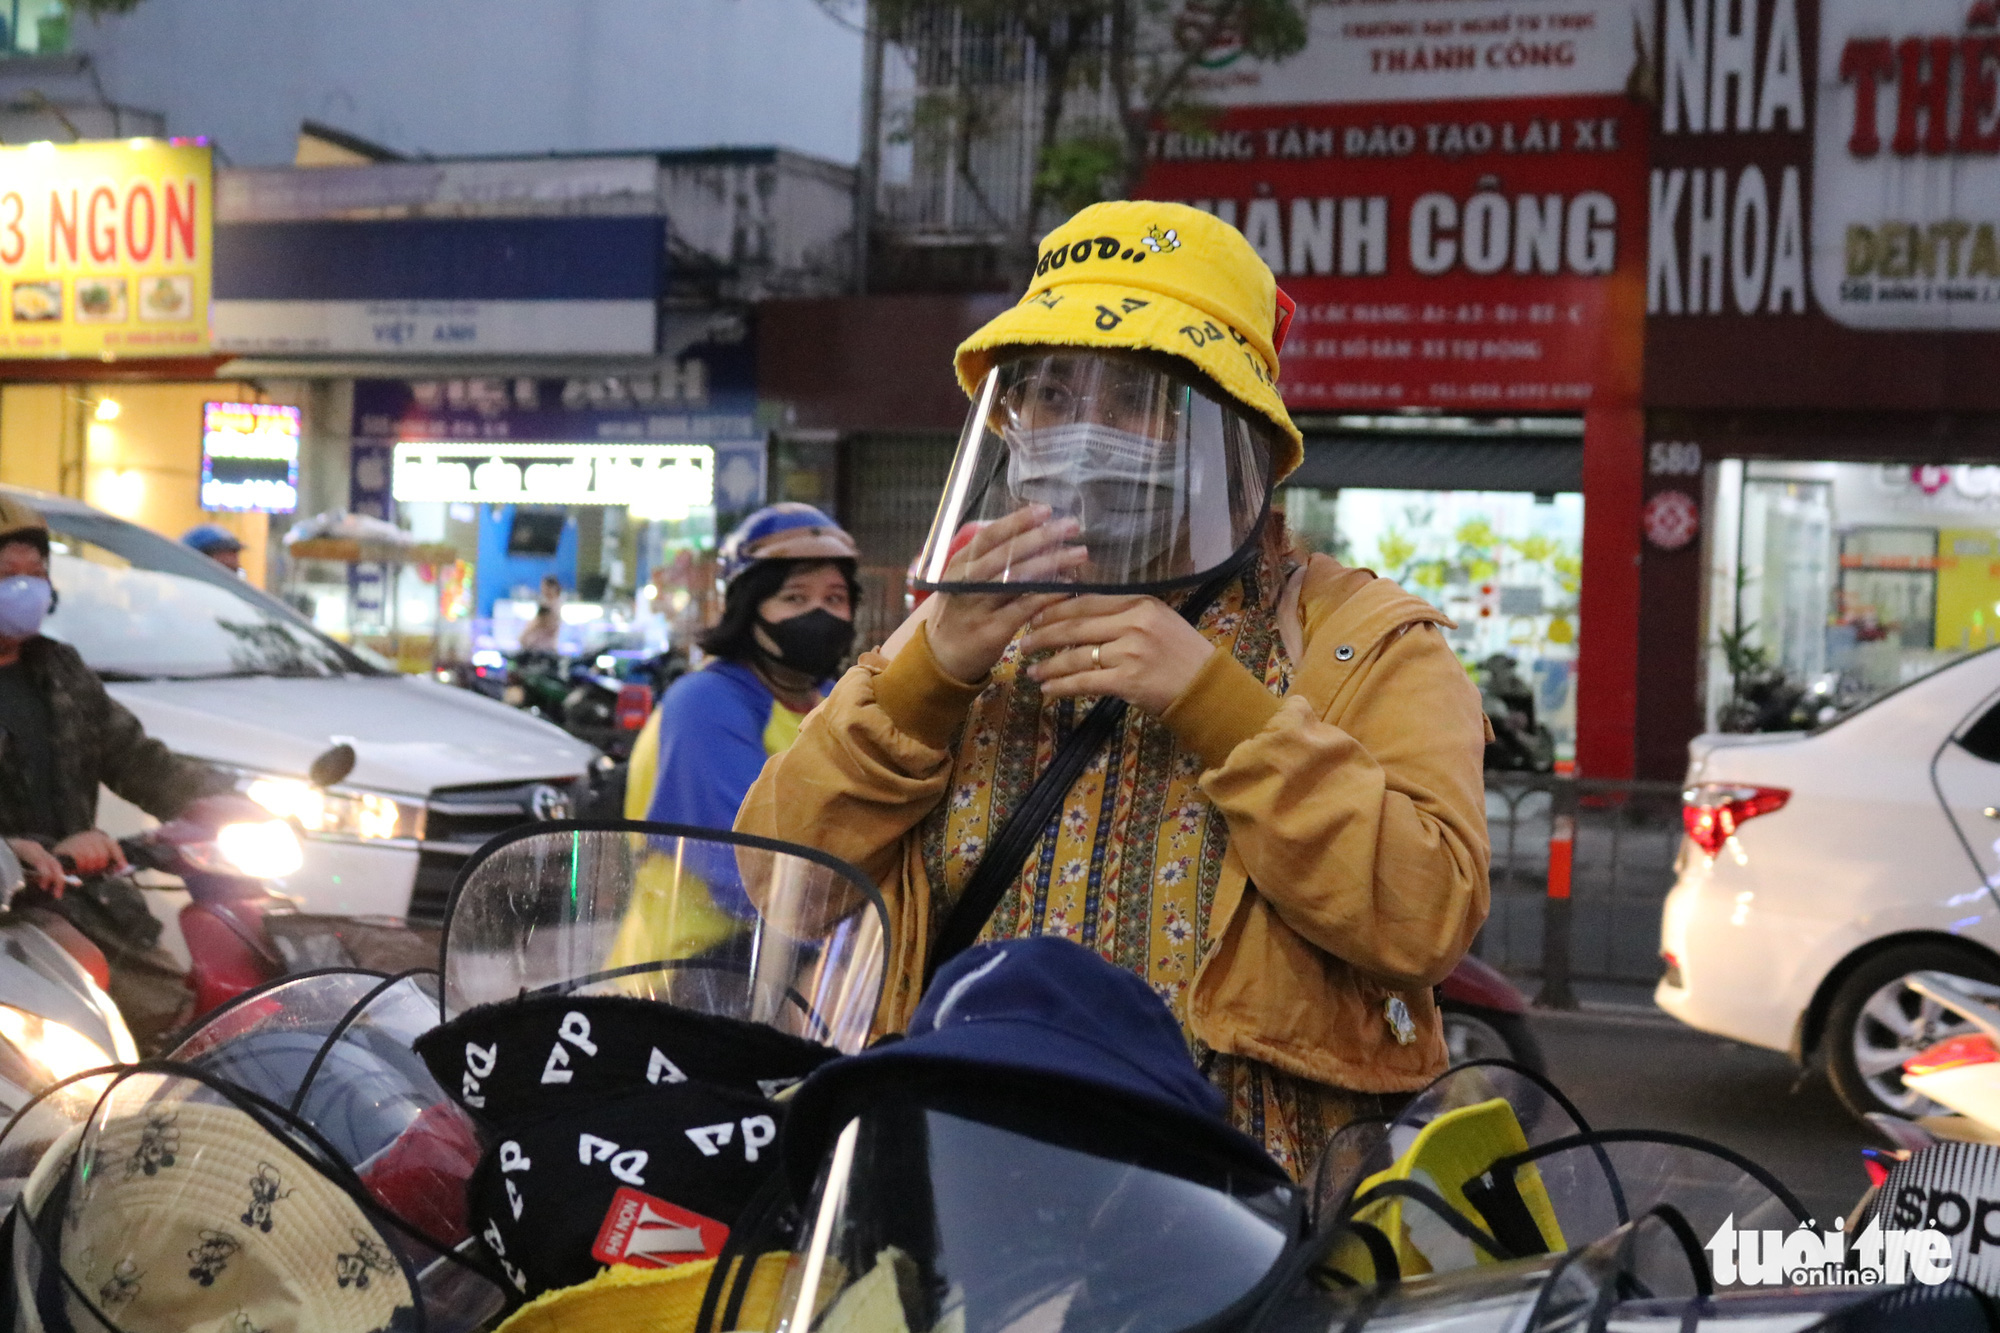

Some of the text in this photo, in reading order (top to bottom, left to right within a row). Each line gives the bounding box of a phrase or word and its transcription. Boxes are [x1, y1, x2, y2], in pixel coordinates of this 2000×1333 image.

[1485, 37, 1575, 69] CÔNG
[1662, 0, 1805, 133] NHA
[1573, 117, 1618, 151] XE
[50, 183, 196, 264] NGON
[1409, 174, 1617, 276] CÔNG
[1648, 164, 1806, 315] KHOA
[1650, 441, 1701, 476] 580
